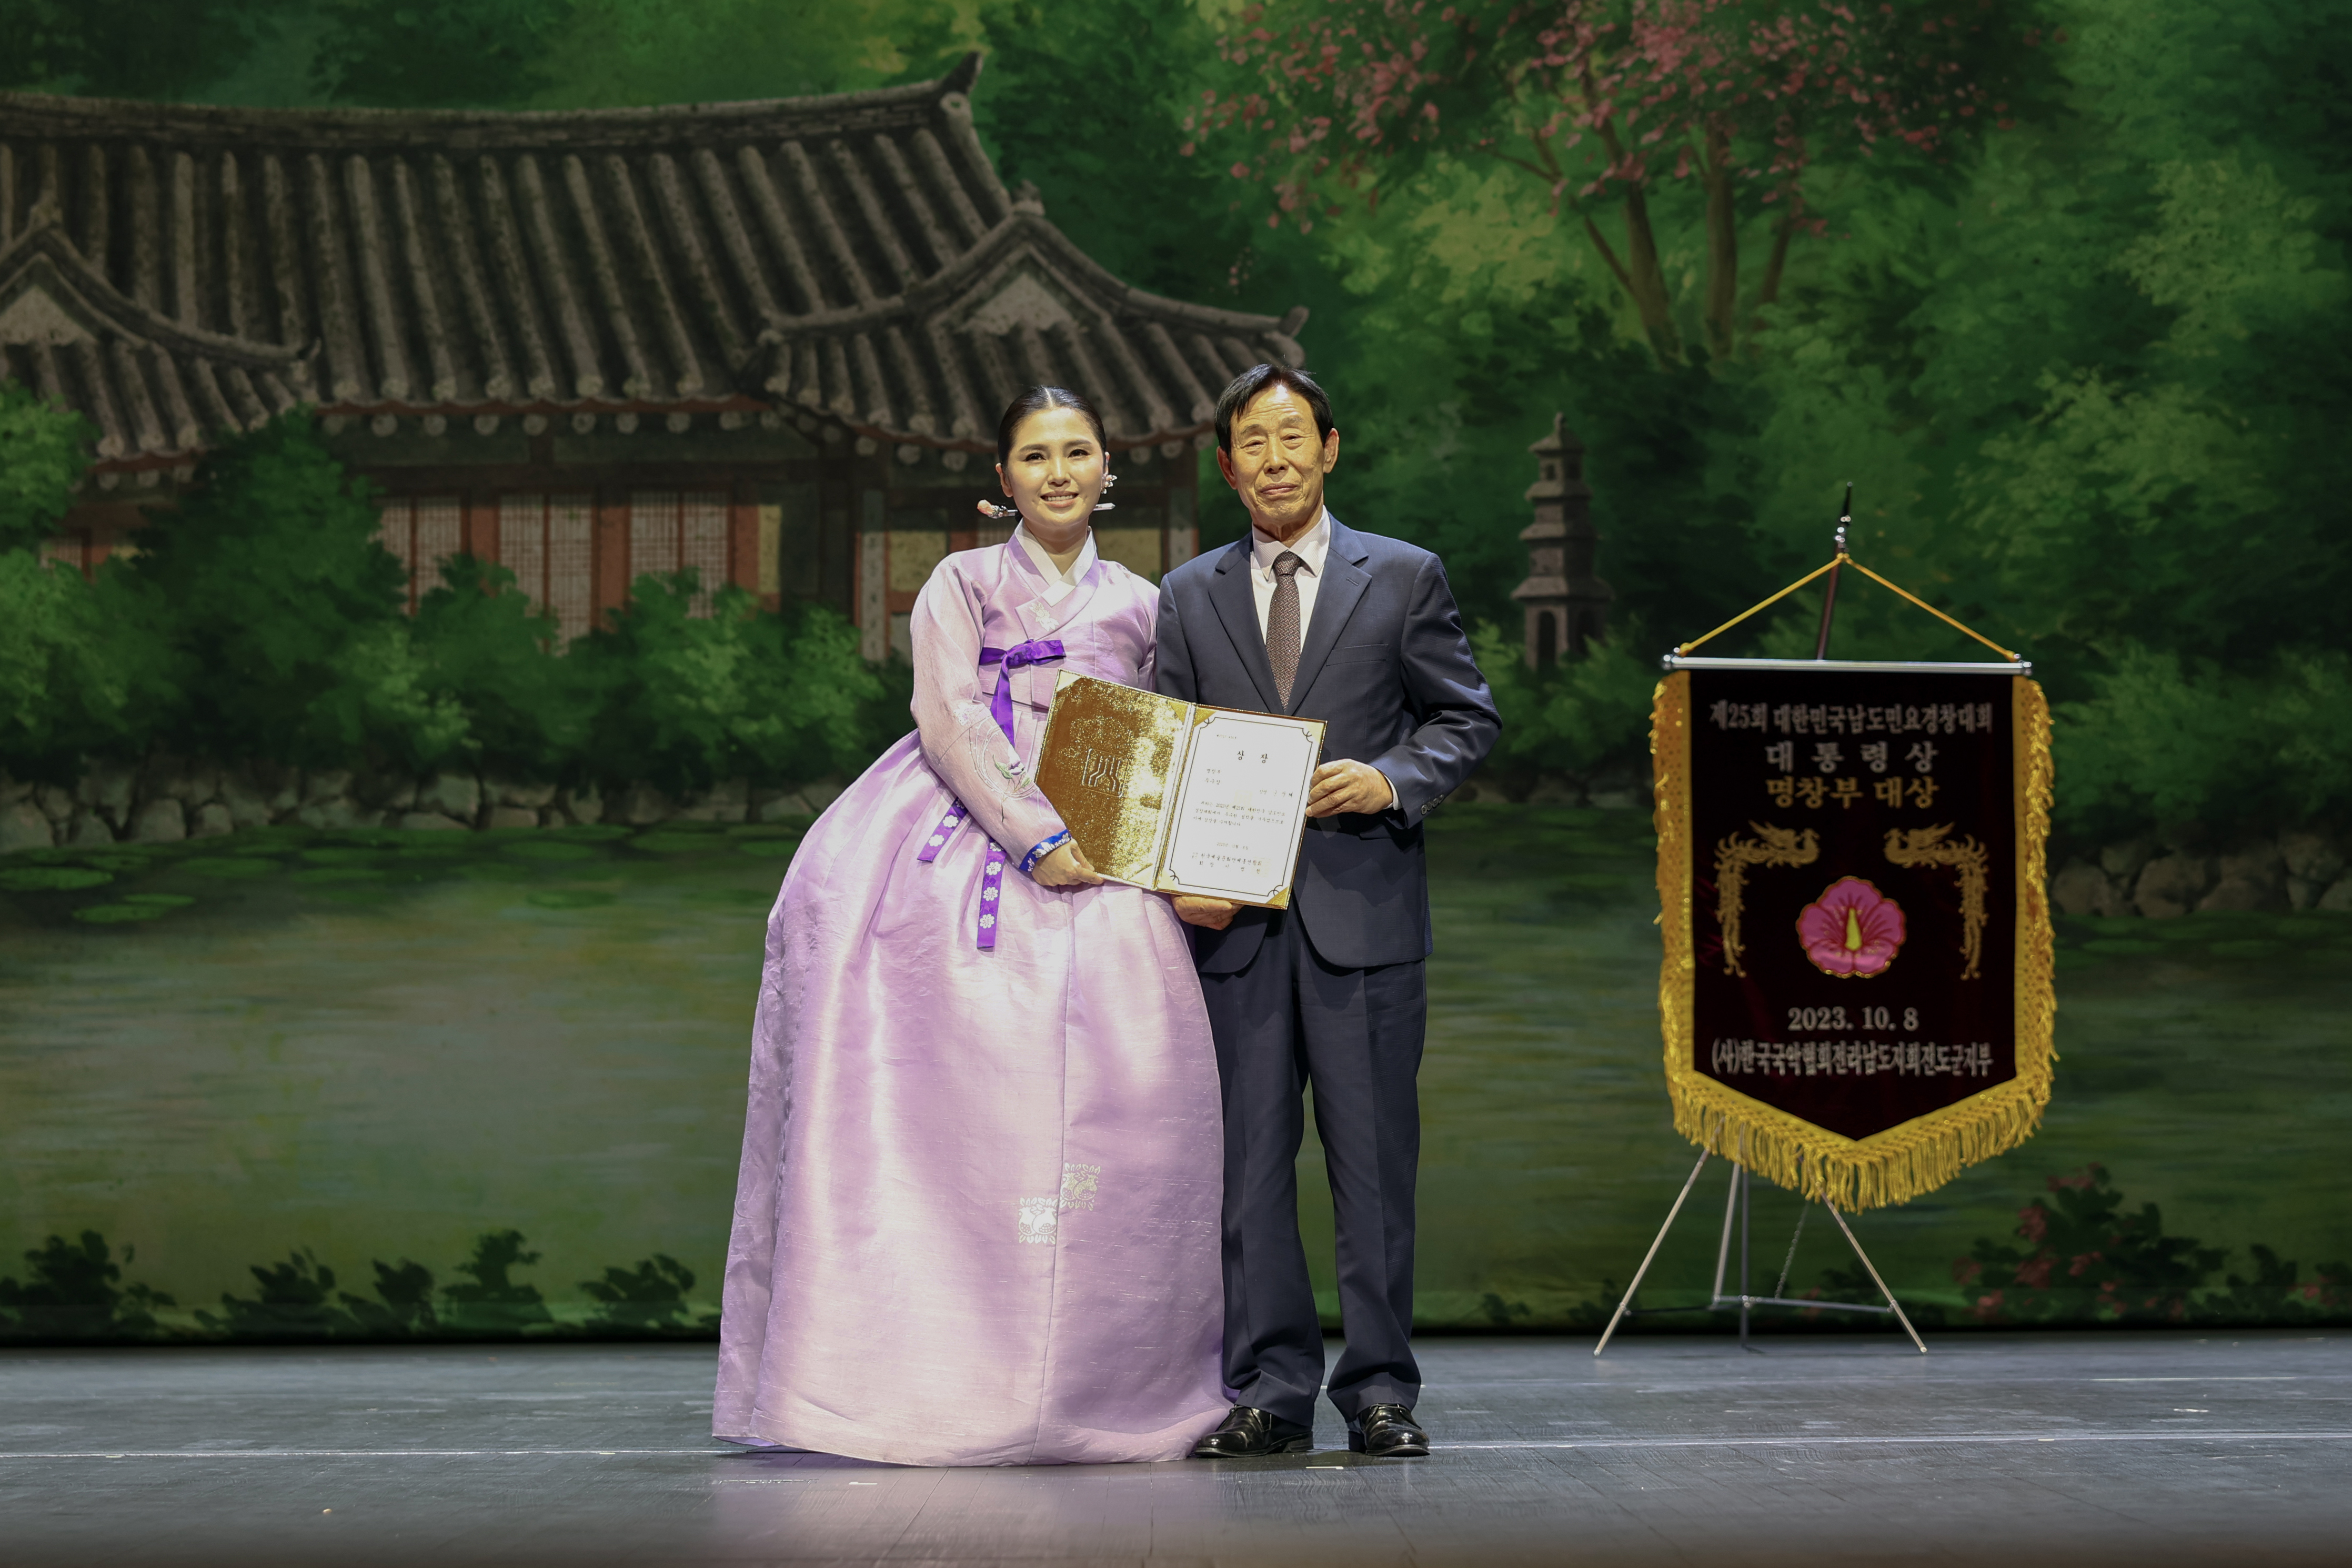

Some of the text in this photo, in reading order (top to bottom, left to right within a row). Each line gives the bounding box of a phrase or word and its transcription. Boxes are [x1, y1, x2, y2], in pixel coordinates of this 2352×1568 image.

[1710, 700, 1993, 734] 제25회 대한민국남도민요경창대회
[1766, 776, 1939, 809] 명창부 대상
[1788, 1006, 1919, 1031] 2023. 10. 8
